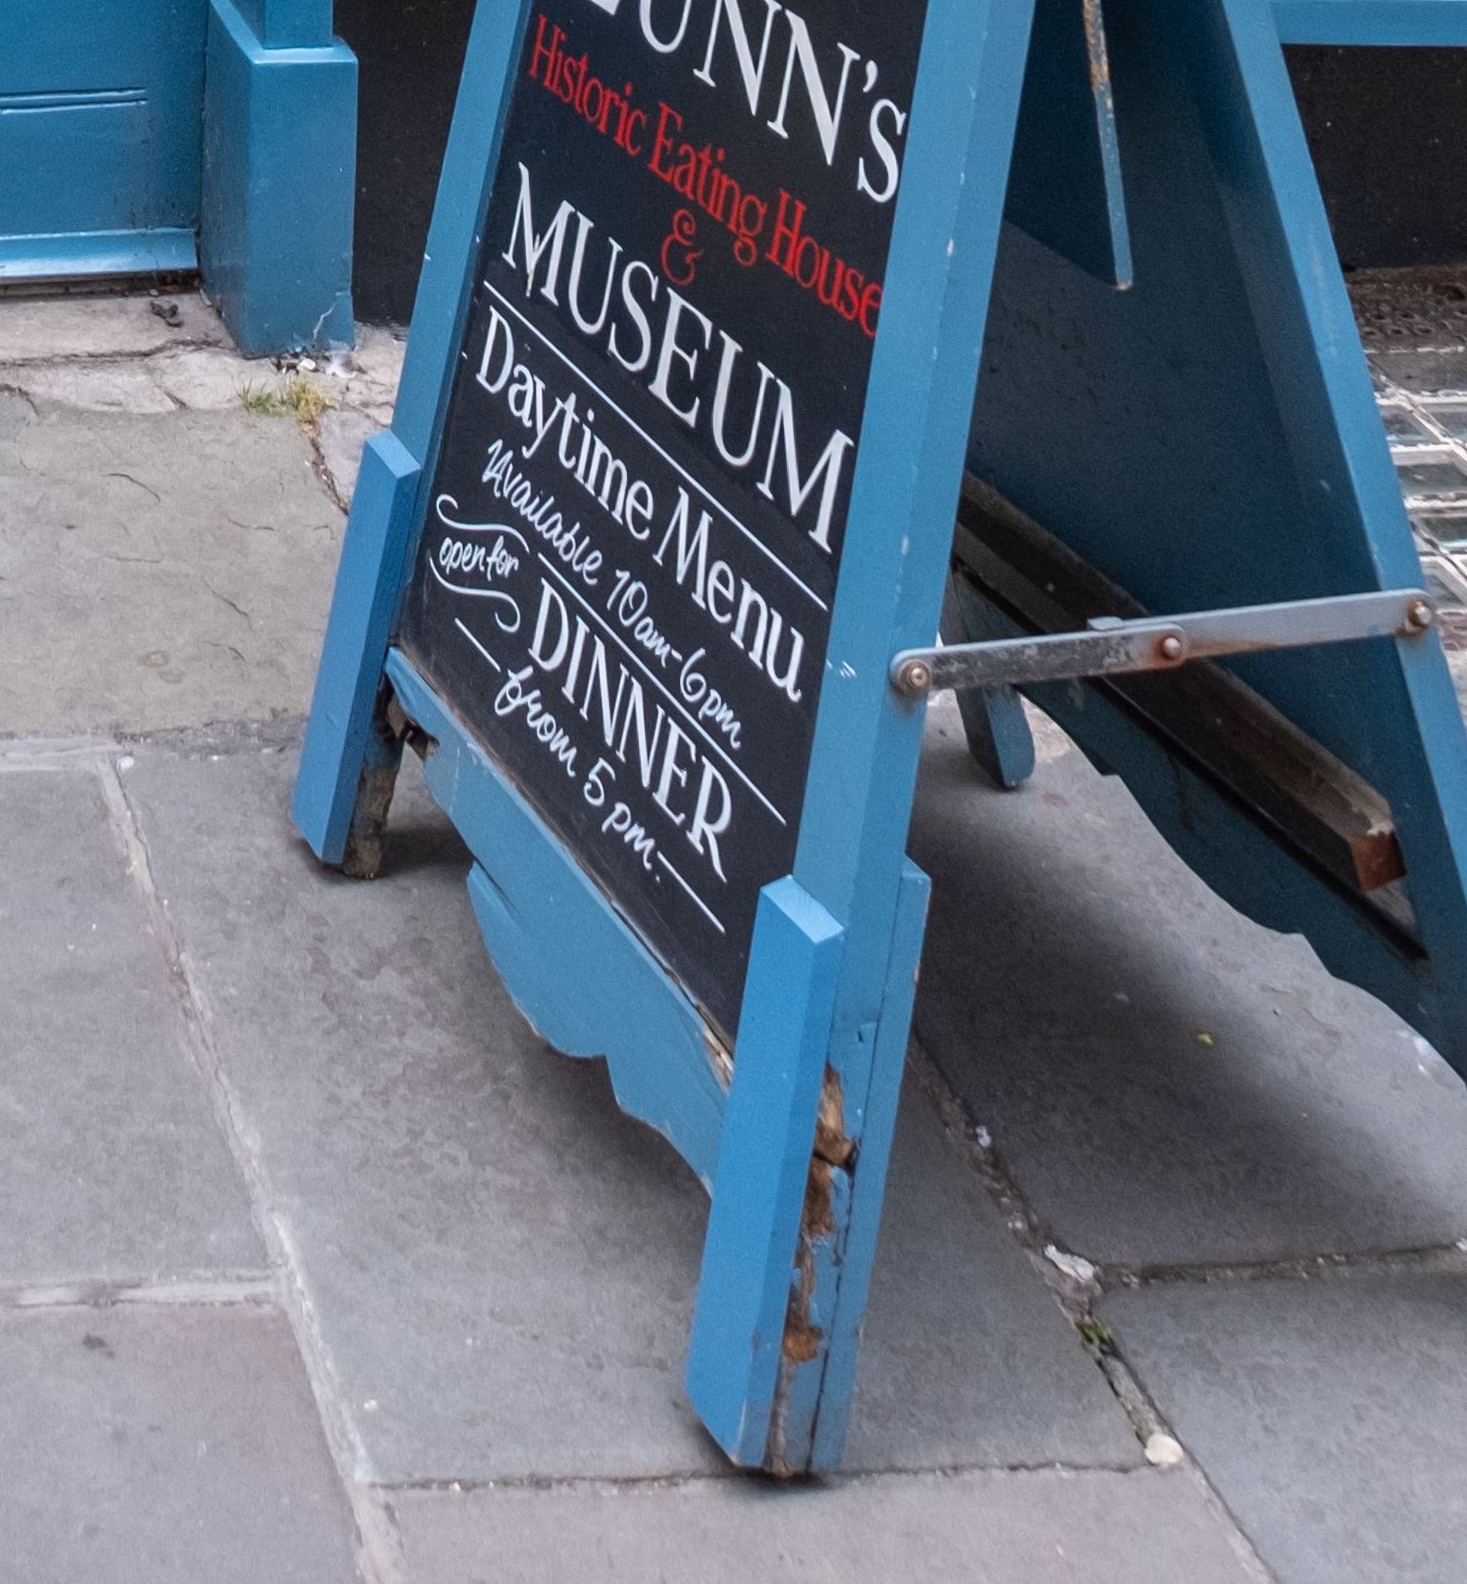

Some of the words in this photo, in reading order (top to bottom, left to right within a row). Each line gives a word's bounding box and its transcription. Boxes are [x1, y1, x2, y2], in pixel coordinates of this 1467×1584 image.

[527, 13, 648, 157] Historic
[647, 100, 768, 267] Eating
[766, 188, 885, 337] House
[660, 208, 705, 286] &
[501, 161, 856, 554] MUSEUM
[439, 536, 485, 575] open
[485, 535, 520, 581] for
[475, 305, 656, 540] Daytime
[652, 486, 804, 703] Menu
[481, 438, 604, 586] Available
[494, 664, 579, 778] from
[528, 576, 735, 883] DINNER
